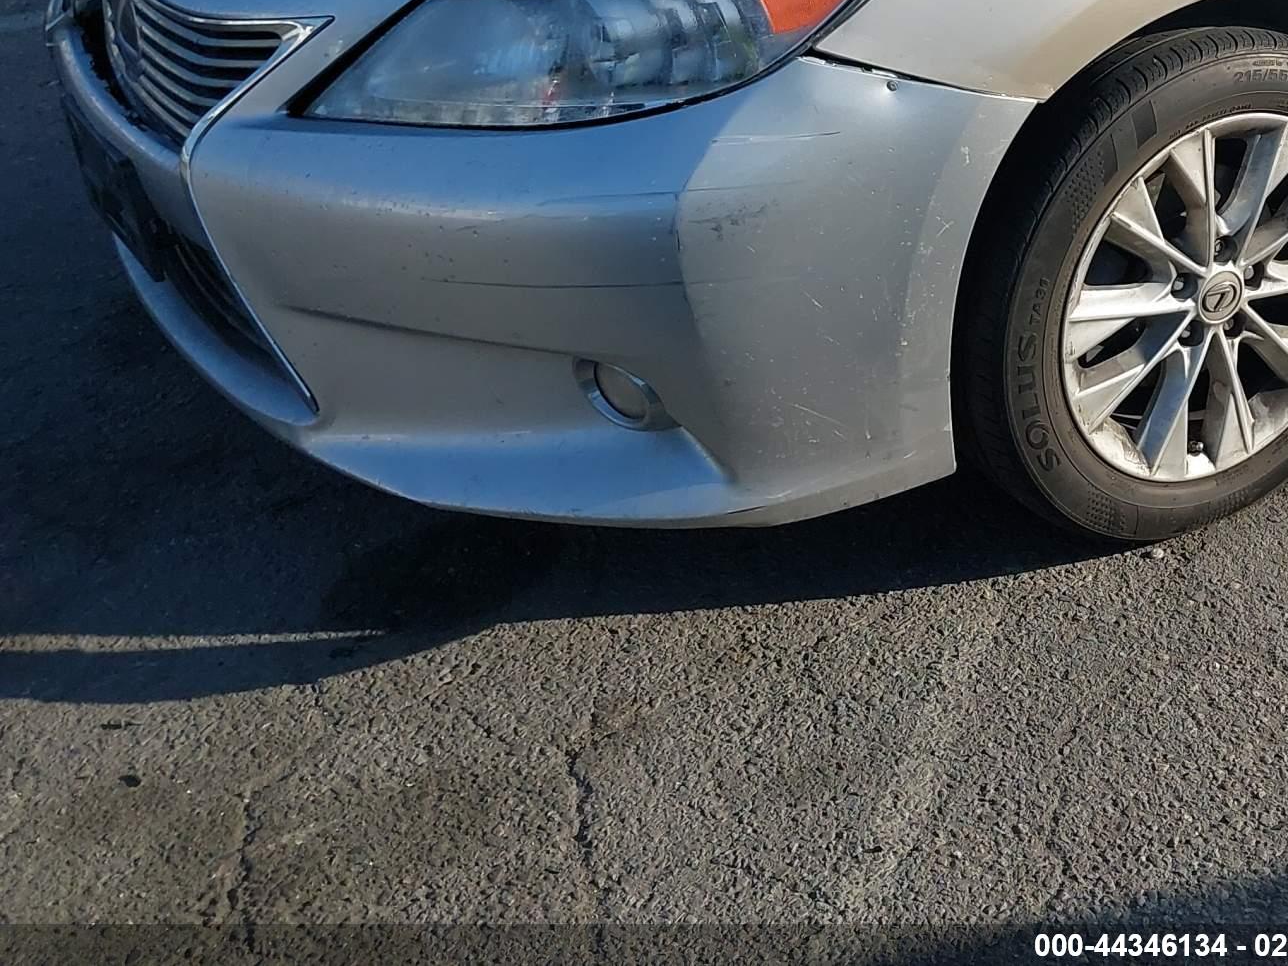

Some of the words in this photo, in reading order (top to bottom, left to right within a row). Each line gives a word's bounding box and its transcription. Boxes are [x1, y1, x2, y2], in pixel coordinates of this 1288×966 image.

[1232, 68, 1288, 83] 215/55
[1029, 276, 1050, 326] TA31
[1017, 332, 1061, 472] SOLUS
